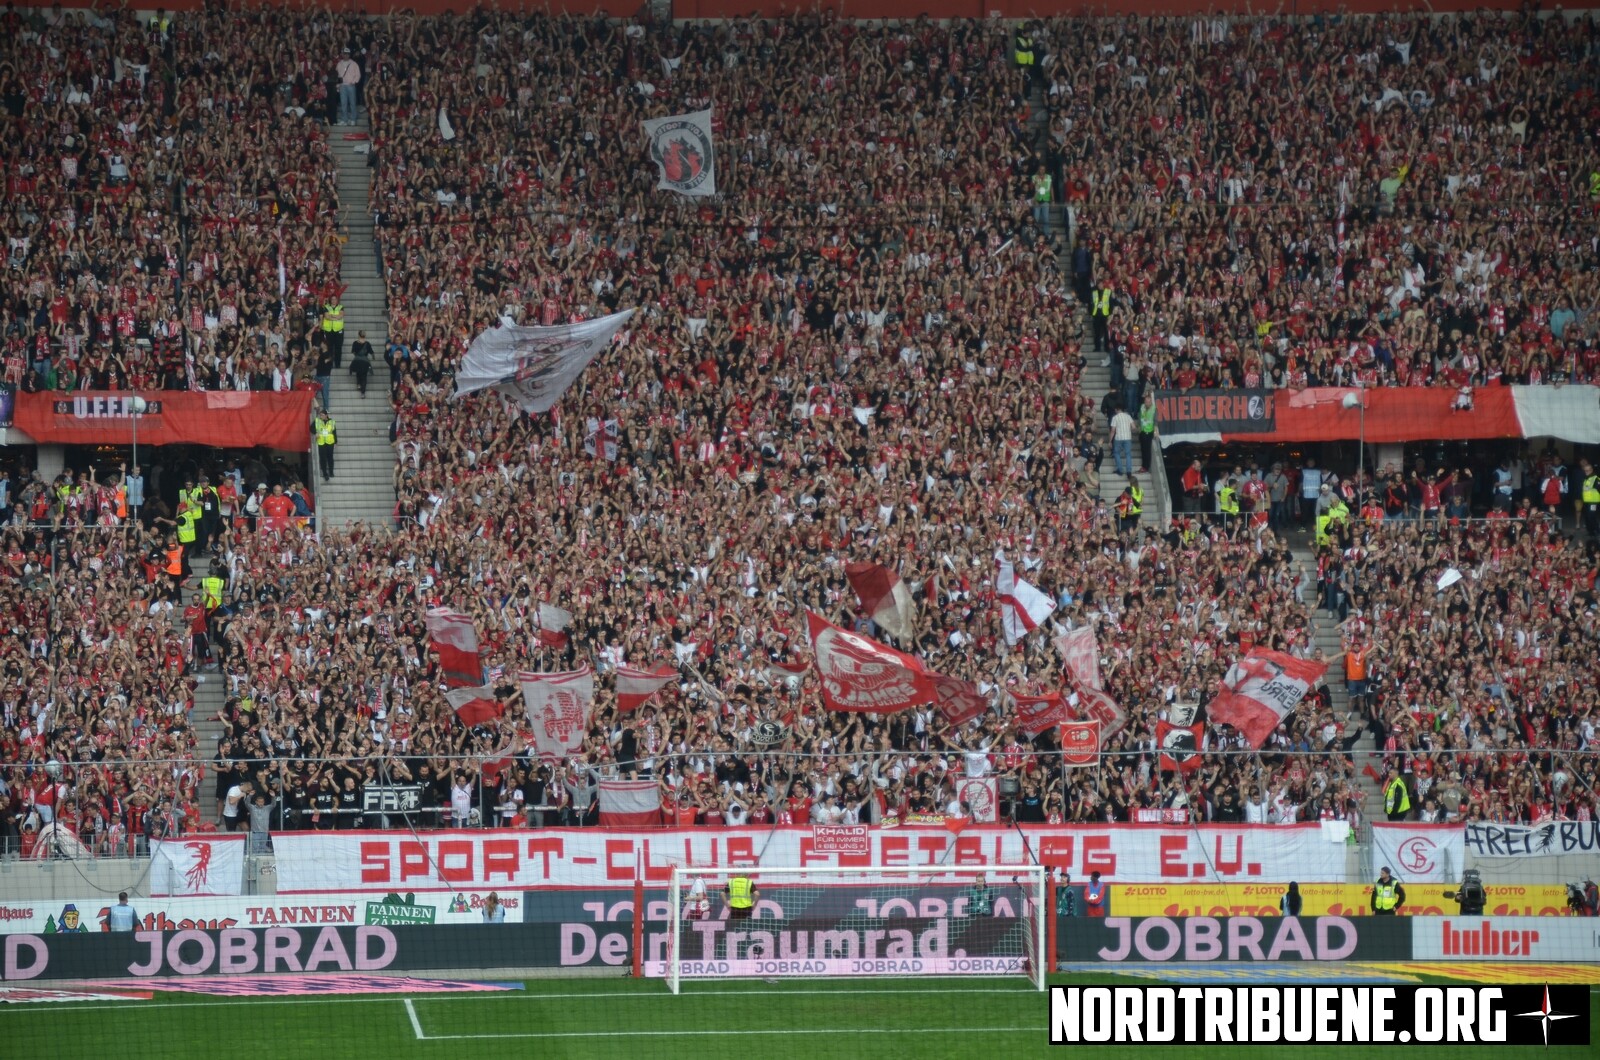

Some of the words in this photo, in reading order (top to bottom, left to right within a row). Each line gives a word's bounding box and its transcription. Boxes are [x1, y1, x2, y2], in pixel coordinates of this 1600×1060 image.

[846, 682, 918, 704] JAHRE
[816, 827, 865, 836] KHALID
[1560, 821, 1600, 852] BU
[816, 835, 835, 843] FÜR
[360, 837, 760, 883] SPORT-CLUB
[1137, 887, 1167, 896] LOTTO
[1184, 887, 1225, 896] lotto-bw.de
[1255, 886, 1286, 895] LOTTO
[1301, 888, 1344, 896] lotto-bw.de
[1495, 887, 1526, 896] LOTTO
[246, 905, 357, 925] TANNEN
[369, 904, 433, 919] TANNEN
[691, 918, 968, 960] Traumrad.
[1097, 915, 1358, 962] JOBRAD
[1442, 920, 1540, 956] huber
[0, 933, 49, 981] D
[127, 925, 398, 977] JOBRAD
[754, 961, 827, 974] JOBRAD
[851, 960, 924, 973] JOBRAD
[947, 959, 1021, 972] JOBRAD
